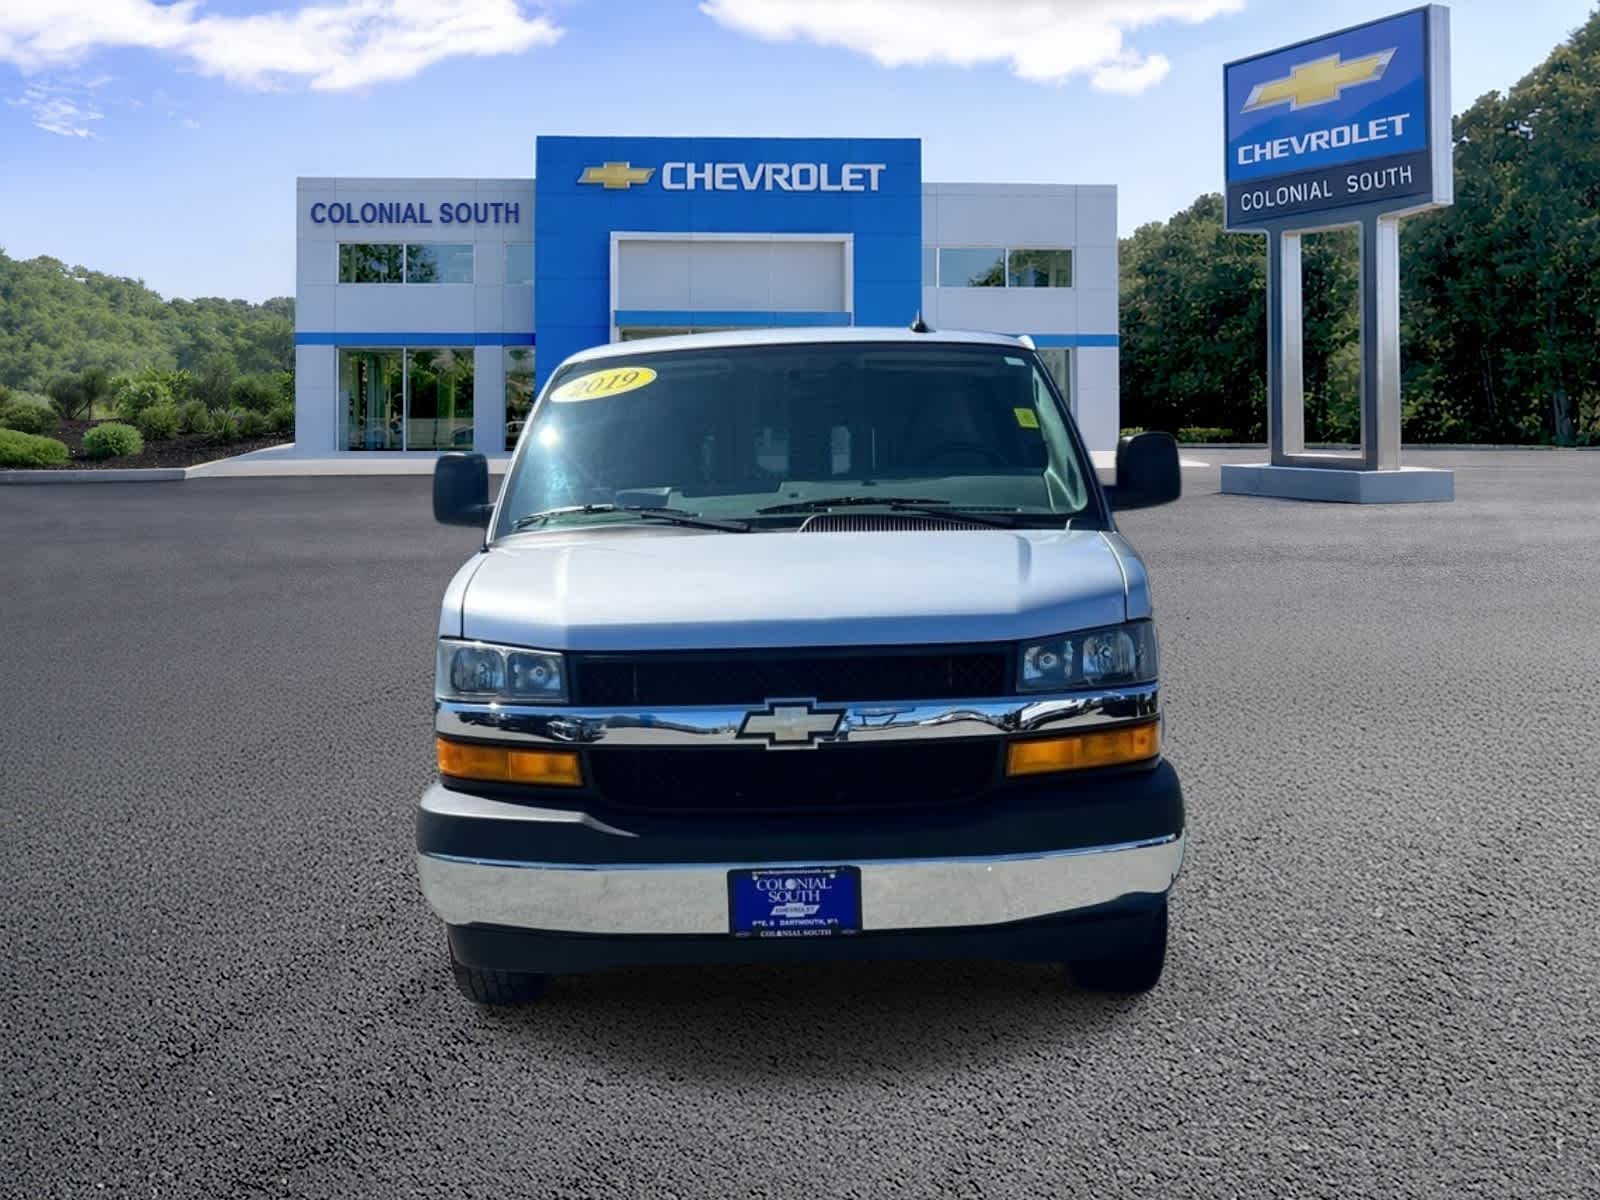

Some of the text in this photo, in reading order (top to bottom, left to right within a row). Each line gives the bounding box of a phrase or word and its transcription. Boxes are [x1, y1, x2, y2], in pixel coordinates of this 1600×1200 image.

[1237, 112, 1410, 165] CHEVROLET
[661, 161, 887, 192] CHEVROLET
[1240, 165, 1413, 211] COLONIAL SOUTH
[310, 202, 520, 224] COLONIAL SOUTH
[569, 370, 640, 398] 2019
[755, 877, 833, 891] COLONIAL
[768, 889, 821, 903] SOUTH
[803, 928, 832, 937] SOUTH
